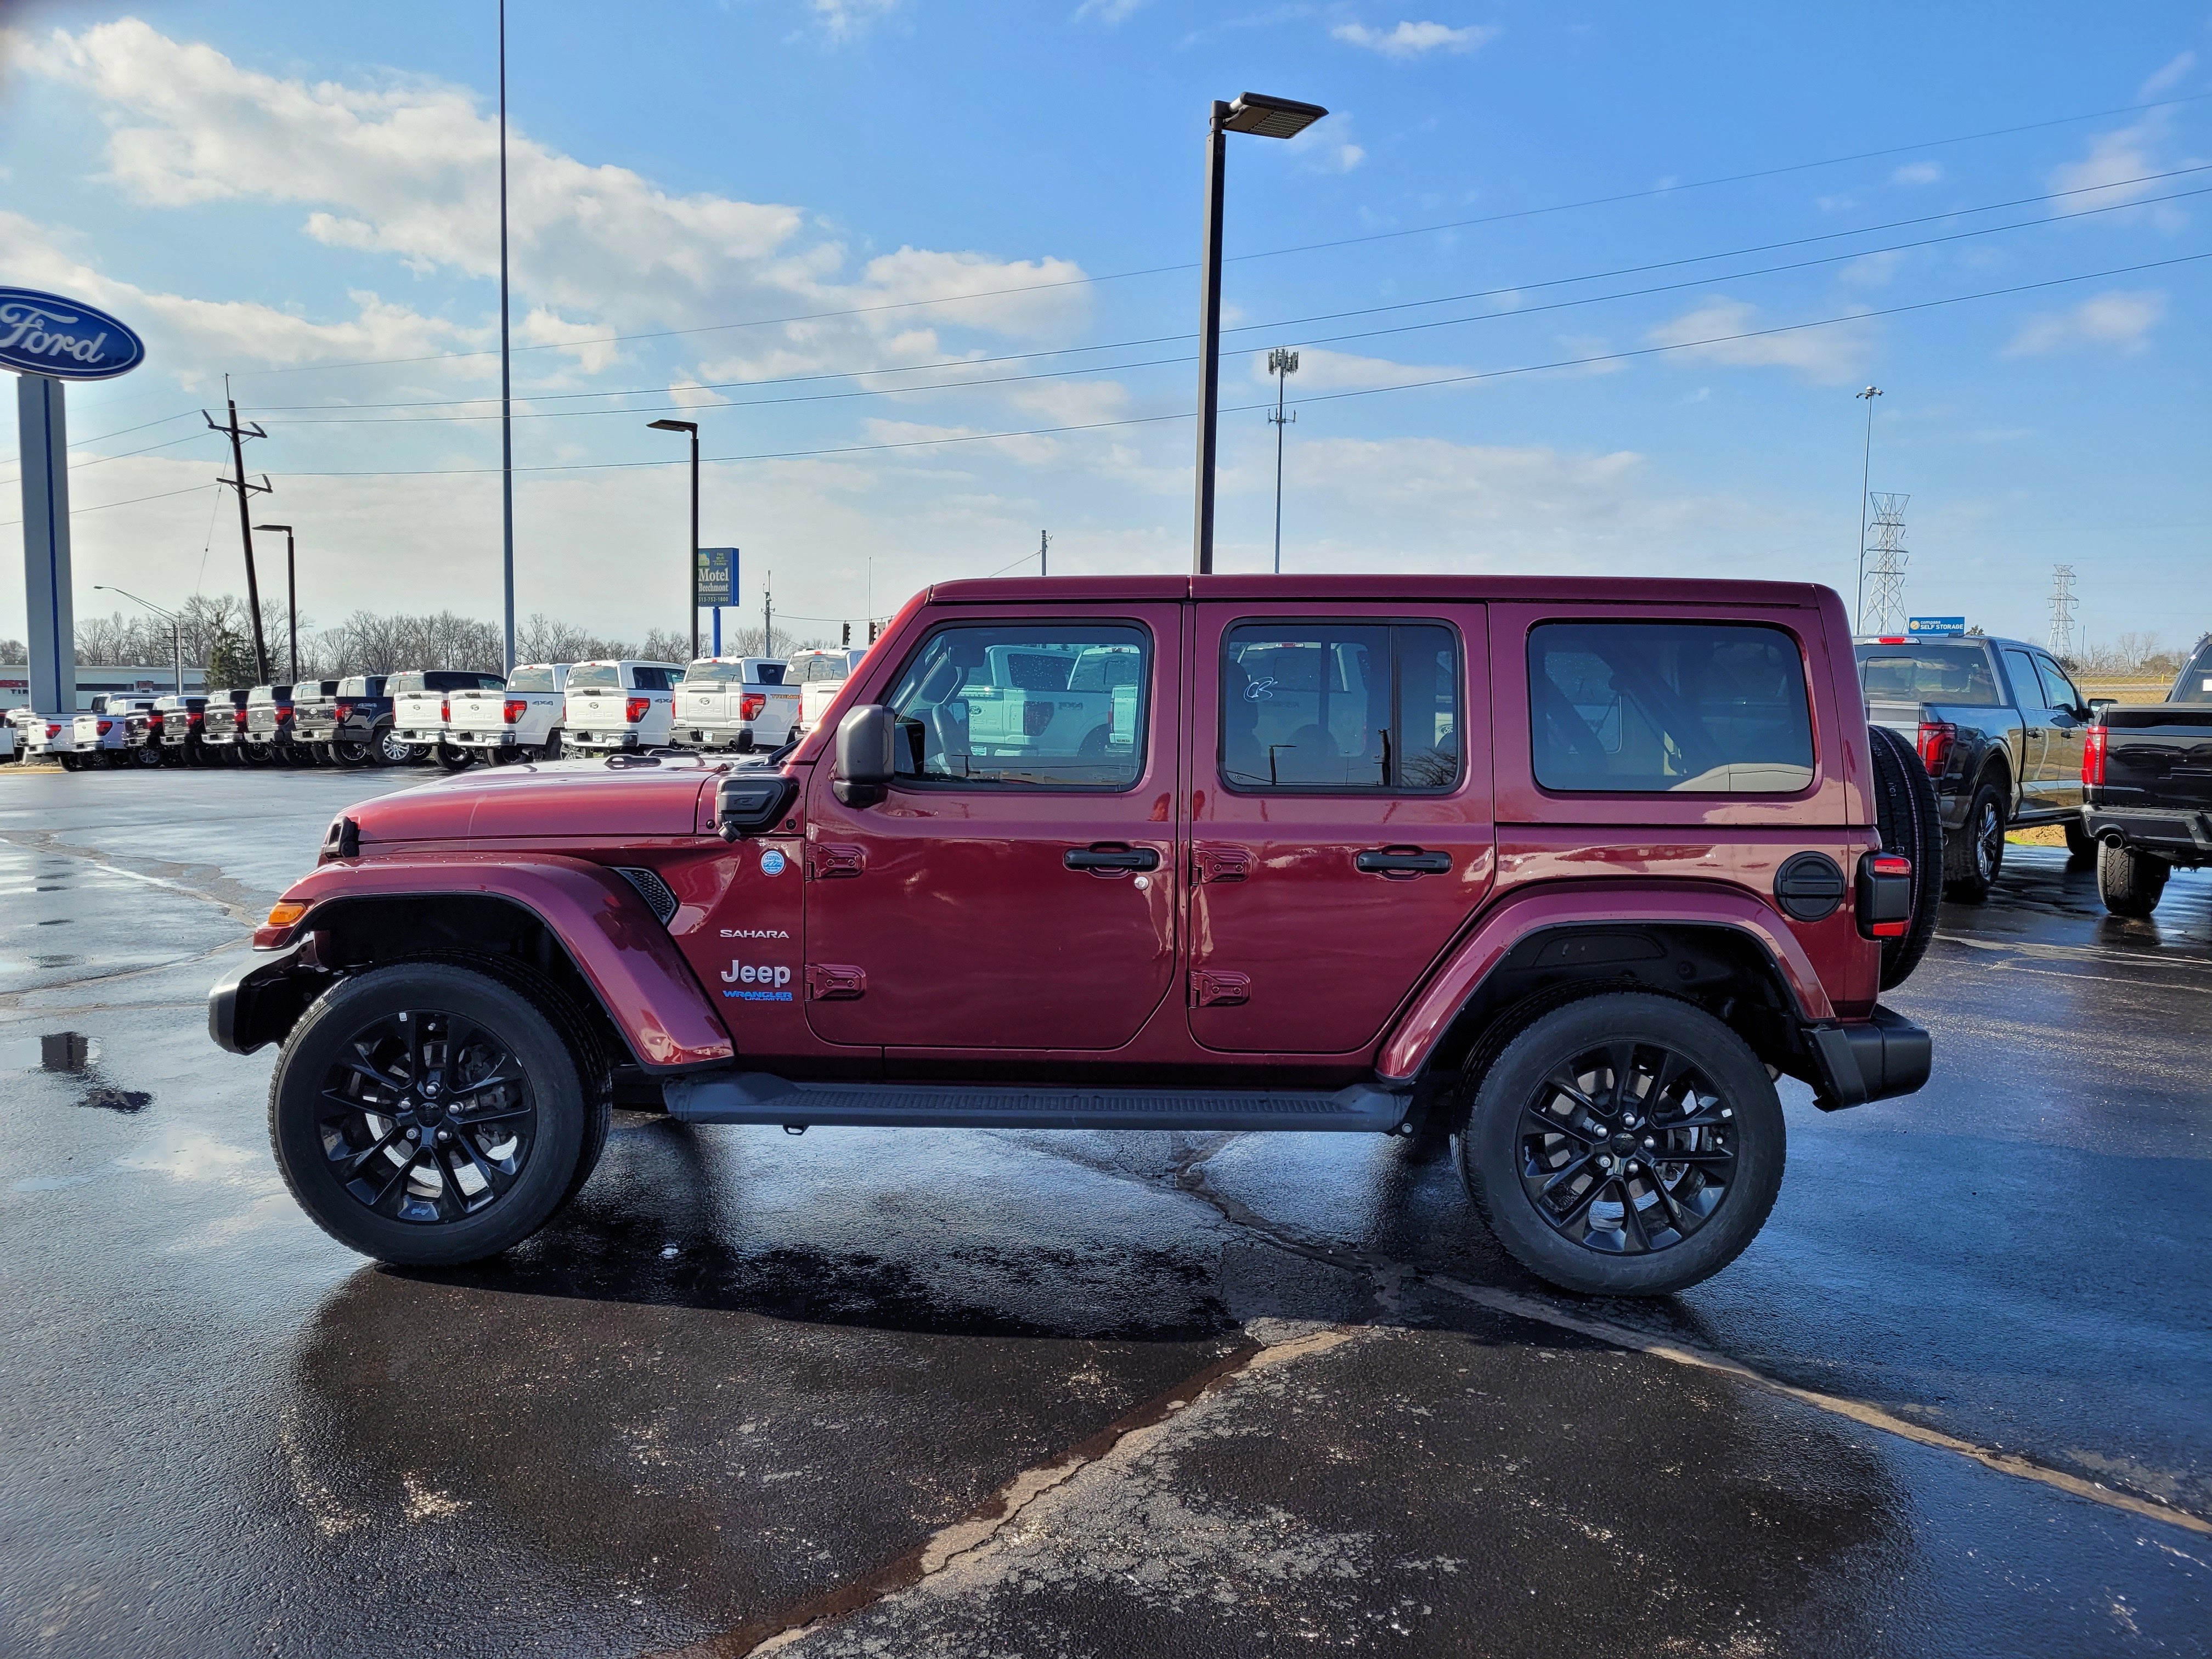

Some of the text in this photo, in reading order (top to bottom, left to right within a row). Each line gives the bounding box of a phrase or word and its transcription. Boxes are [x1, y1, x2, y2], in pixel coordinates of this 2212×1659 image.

[0, 303, 108, 363] Ford
[698, 567, 729, 581] Motel
[698, 582, 729, 592] Beechmont
[720, 930, 789, 939] SAHARA
[721, 960, 791, 988] Jeep
